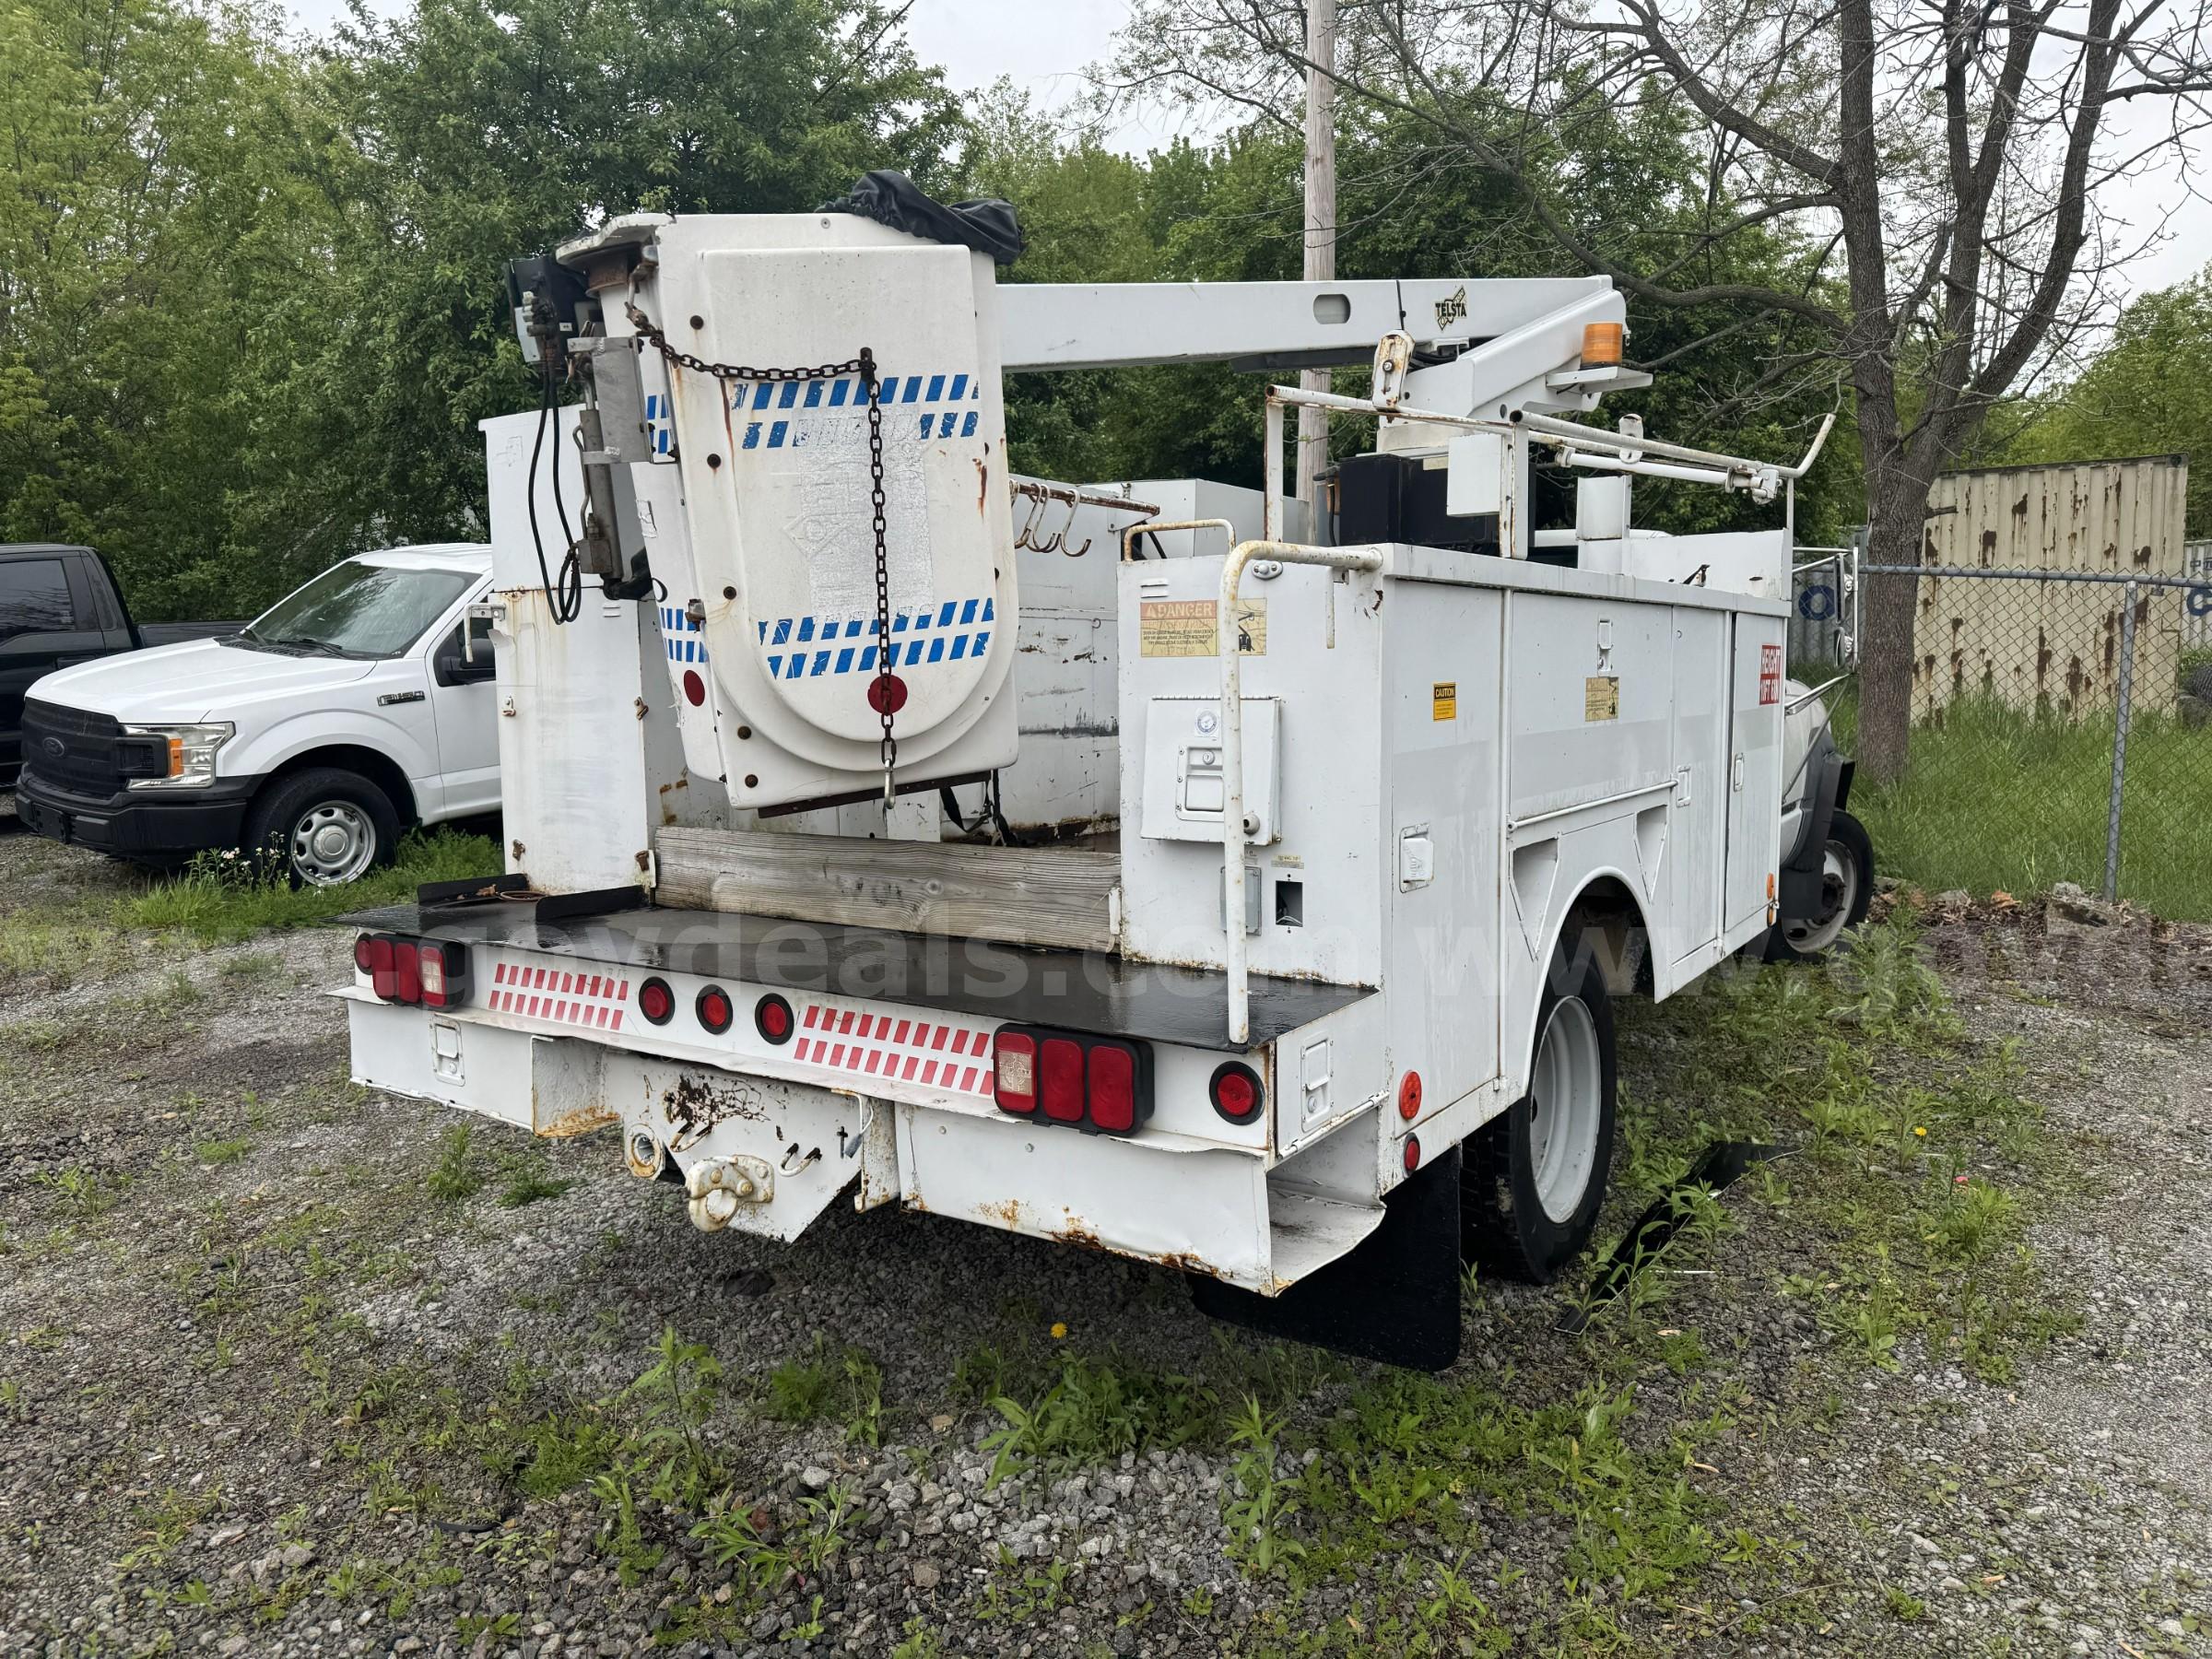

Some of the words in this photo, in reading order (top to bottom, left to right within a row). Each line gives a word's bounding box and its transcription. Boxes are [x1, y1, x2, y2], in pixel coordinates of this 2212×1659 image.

[1435, 302, 1467, 317] TELSTA
[1158, 603, 1213, 618] DANGER
[1760, 648, 1781, 675] HEIGHT
[1435, 688, 1454, 699] CAUTION
